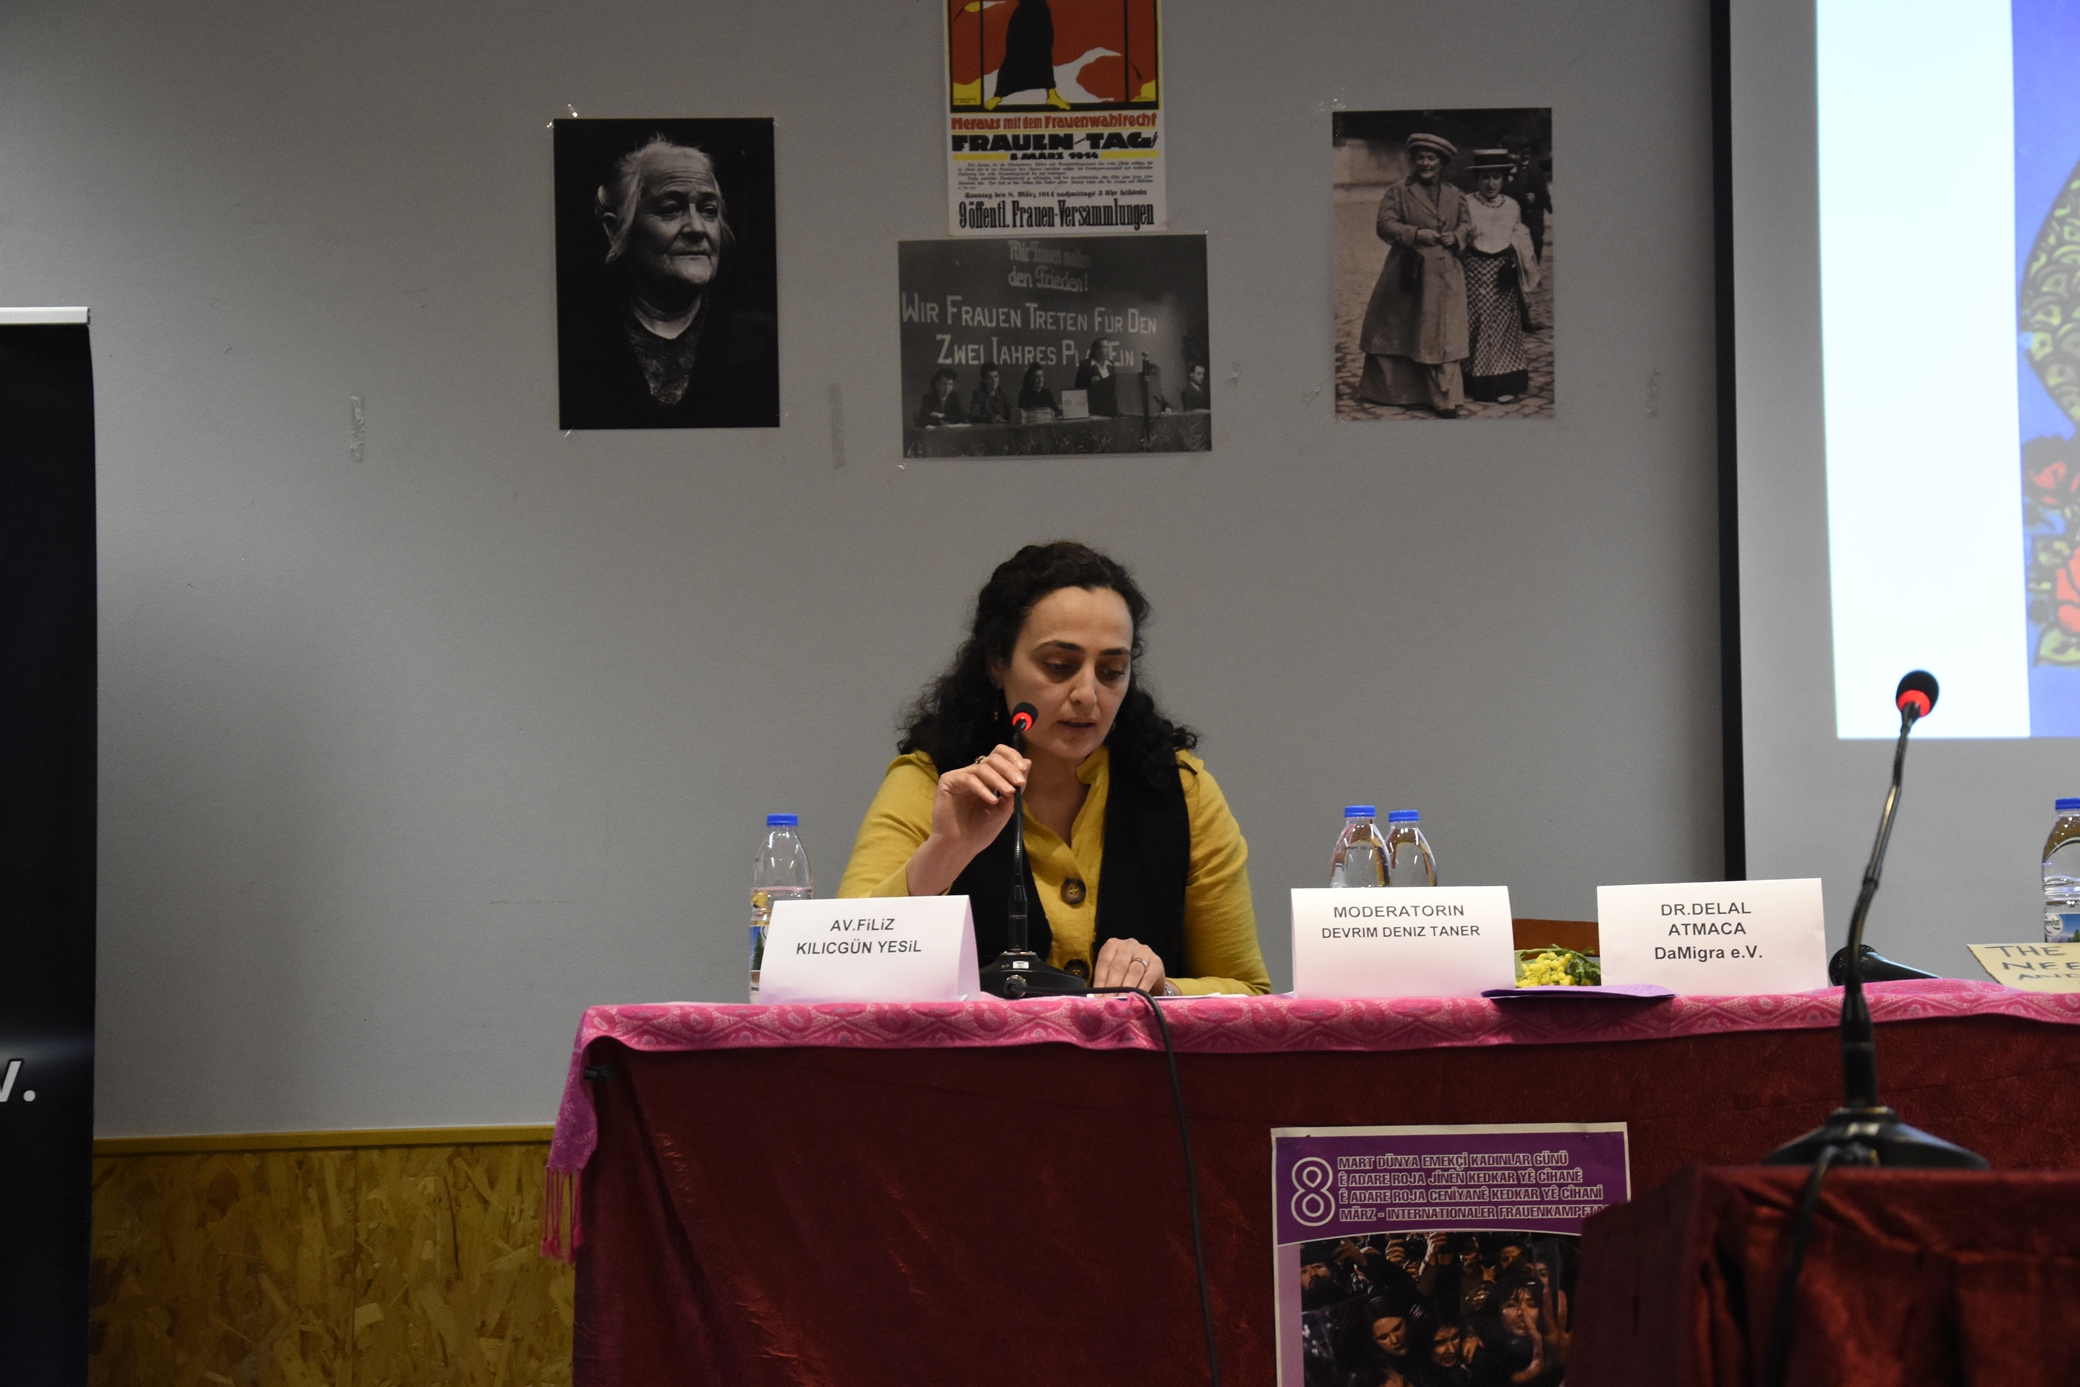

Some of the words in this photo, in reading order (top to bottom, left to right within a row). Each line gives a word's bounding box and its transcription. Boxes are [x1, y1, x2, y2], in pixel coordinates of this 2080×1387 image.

[1003, 116, 1021, 129] mit
[1023, 116, 1042, 129] dem
[1044, 113, 1157, 129] Frauenwahlrecht
[958, 200, 968, 229] 9
[968, 199, 1011, 229] öffentl.
[1007, 265, 1033, 288] den
[1034, 264, 1089, 293] Frieden!
[1333, 904, 1465, 918] MODERATORIN
[1660, 901, 1752, 916] DR.DELAL
[1321, 926, 1378, 939] DEVRIM
[1382, 926, 1426, 938] DENIZ
[1429, 925, 1480, 937] TANER
[1668, 921, 1747, 936] ATMACA
[796, 939, 873, 955] KILICGÜN
[1654, 945, 1725, 963] DaMigra
[1730, 944, 1763, 959] e.V.
[1984, 945, 2067, 958] THE
[1337, 1155, 1375, 1170] MART
[1376, 1152, 1421, 1169] DÜNYA
[1470, 1152, 1532, 1168] KADINLAR
[1533, 1149, 1569, 1167] GÜNÜ
[1338, 1171, 1348, 1187] Ê
[1349, 1172, 1390, 1187] ADARE
[1391, 1171, 1426, 1186] ROJA
[1467, 1169, 1518, 1184] KEDKAR
[1518, 1168, 1535, 1184] YÊ
[1291, 1156, 1335, 1227] 8
[1339, 1188, 1348, 1204] Ê
[1350, 1189, 1391, 1204] ADARE
[1392, 1188, 1427, 1203] ROJA
[1490, 1187, 1541, 1201] KEDKAR
[1541, 1185, 1559, 1201] YÊ
[1339, 1206, 1377, 1221] MÄRZ
[1386, 1206, 1497, 1221] INTERNATIONALER
